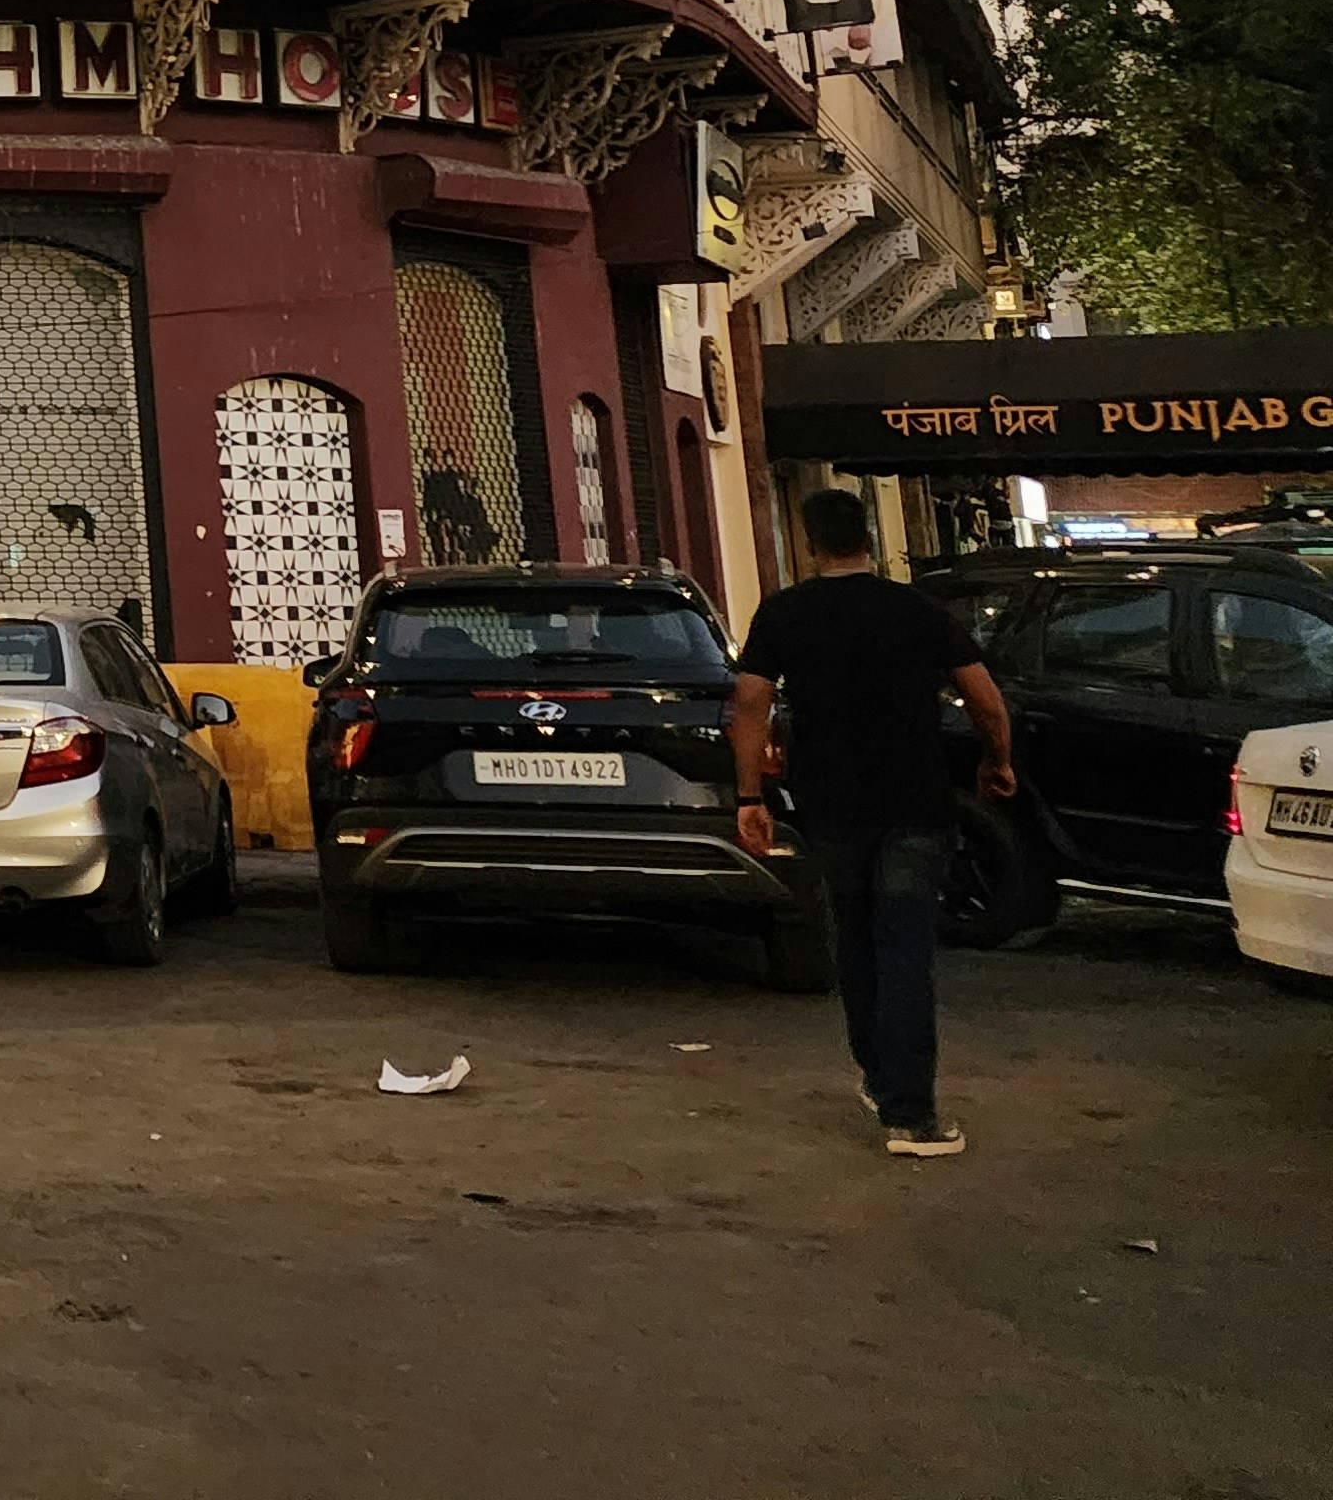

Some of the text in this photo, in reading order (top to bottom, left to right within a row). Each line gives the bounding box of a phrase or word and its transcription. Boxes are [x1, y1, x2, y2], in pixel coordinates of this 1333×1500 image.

[881, 394, 1059, 437] पंजाब ग्रिल
[1099, 397, 1289, 441] PUNJAB
[490, 758, 621, 780] MH01DT4922
